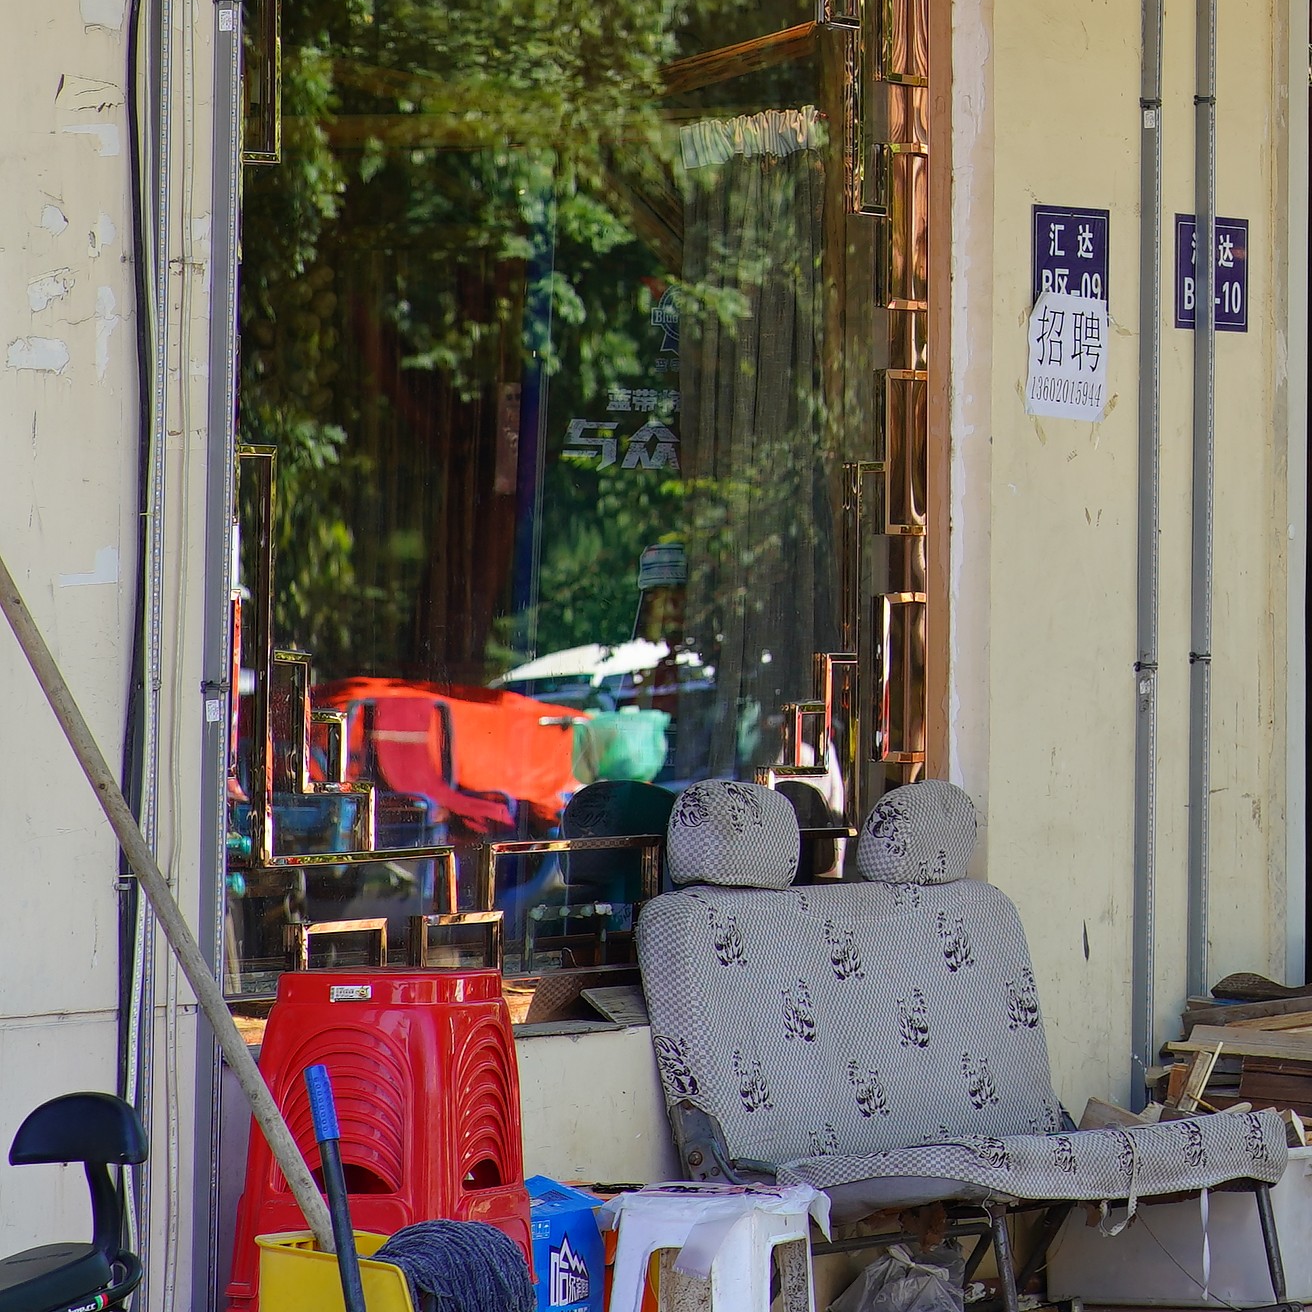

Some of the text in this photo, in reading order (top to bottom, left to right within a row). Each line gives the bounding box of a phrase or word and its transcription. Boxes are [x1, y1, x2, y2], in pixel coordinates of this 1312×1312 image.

[1049, 222, 1094, 260] 汇达
[1041, 268, 1102, 300] B区-09
[1183, 276, 1242, 315] B-10
[1036, 303, 1103, 373] 招聘
[1031, 375, 1102, 409] 13602015944
